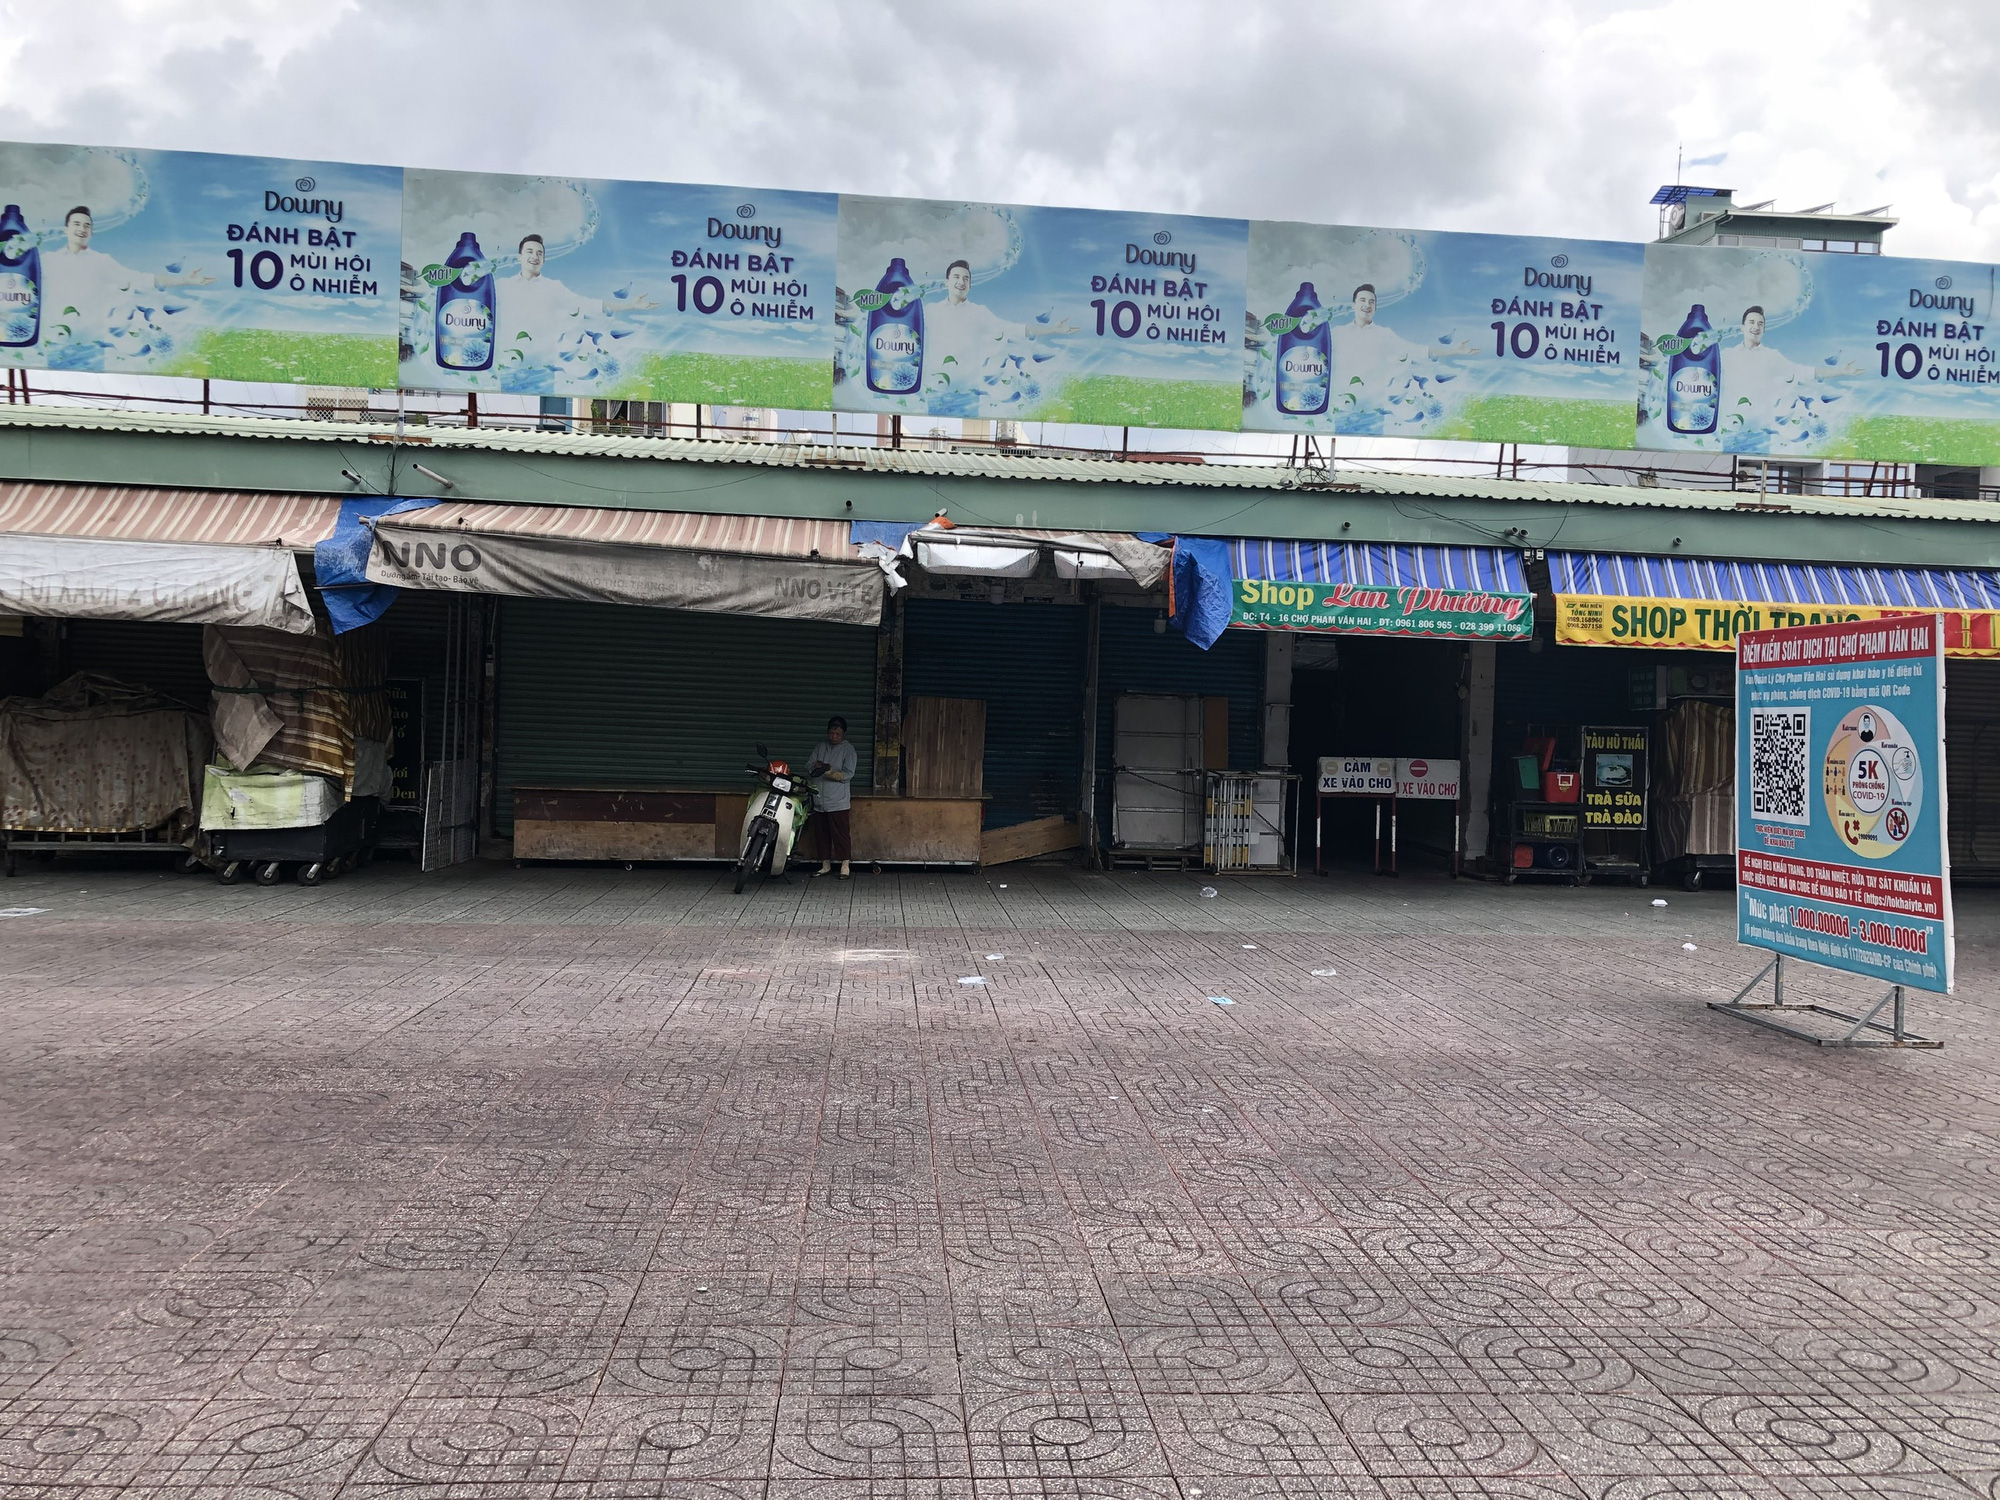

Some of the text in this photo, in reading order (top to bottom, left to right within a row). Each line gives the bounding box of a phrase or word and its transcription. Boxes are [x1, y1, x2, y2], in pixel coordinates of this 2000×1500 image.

[264, 191, 343, 223] Downy
[227, 222, 356, 250] ĐÁNH BẬT
[707, 217, 782, 248] Downy
[291, 253, 371, 272] MÙI HÔI
[671, 248, 794, 276] ĐÁNH BẬT
[1126, 243, 1195, 274] Downy
[227, 249, 283, 290] 10
[427, 267, 452, 281] MỚI!
[290, 274, 377, 295] Ô NHIỄM
[731, 278, 807, 297] MÙI HÔI
[1091, 273, 1207, 302] ĐÁNH BẬT
[1524, 266, 1592, 296] Downy
[671, 275, 725, 314] 10
[859, 292, 882, 307] MỚI!
[1909, 288, 1974, 318] Downy
[730, 300, 814, 320] Ô NHIỄM
[1090, 299, 1141, 338] 10
[1147, 303, 1220, 322] MÙI HÔI
[1491, 297, 1603, 323] ĐÁNH BẬT
[445, 313, 486, 331] Downy
[1270, 316, 1293, 330] MỚI!
[1877, 318, 1984, 343] ĐÁNH BẬT
[1146, 324, 1225, 344] Ô NHIỄM
[1491, 321, 1540, 359] 10
[1545, 324, 1615, 343] MÙI HÔI
[876, 337, 914, 355] Downy
[1661, 337, 1684, 352] MỚI!
[1929, 345, 1995, 363] MÙI HÔI
[1544, 344, 1620, 365] Ô NHIỄM
[1876, 342, 1923, 380] 10
[1285, 360, 1323, 377] Downy
[1928, 365, 1940, 380] Ô
[1676, 380, 1712, 396] Downy
[382, 541, 481, 572] NNO
[1241, 579, 1525, 620] Shop Lan Phương
[1243, 612, 1257, 620] ĐC:
[1260, 613, 1270, 621] T4
[1279, 614, 1289, 622] 16
[1291, 614, 1309, 624] CHỢ
[1311, 615, 1335, 625] PHẠM
[1338, 615, 1355, 625] VĂN
[1357, 617, 1371, 625] HAI
[1379, 618, 1393, 627] ĐT:
[1395, 619, 1415, 628] 0961
[1418, 620, 1433, 628] 806
[1437, 621, 1452, 629] 965
[1460, 622, 1476, 630] 028
[1478, 622, 1494, 631] 399
[1611, 605, 1687, 638] SHOP
[1694, 603, 1760, 641] THỜI
[1761, 634, 1780, 662] KIỂM
[1782, 636, 1801, 661] SOÁT
[1803, 637, 1822, 661] DỊCH
[1825, 636, 1838, 661] TẠI
[1840, 632, 1859, 659] CHỢ
[1860, 631, 1886, 660] PHẠM
[1889, 625, 1908, 652] VĂN
[1911, 626, 1929, 651] HAI
[1822, 686, 1850, 699] COVID-19
[1881, 685, 1891, 697] QR
[1893, 684, 1910, 695] Code
[1606, 733, 1620, 749] HŨ
[1622, 733, 1644, 750] THÁI
[1858, 761, 1878, 779] 5K
[1323, 777, 1337, 788] XE
[1341, 775, 1364, 788] VÀO
[1403, 782, 1414, 794] XE
[1417, 779, 1435, 795] VÀO
[1853, 781, 1885, 790] PHÒNG CHỐNG
[1586, 790, 1641, 806] TRÀ SỮA
[1853, 791, 1885, 801] COVID-19
[1585, 809, 1642, 825] TRÀ ĐÀO
[1820, 884, 1834, 897] KHAI
[1835, 886, 1847, 900] BÁO
[1849, 889, 1853, 901] Y
[1854, 888, 1862, 902] TẾ
[1866, 875, 1877, 888] TAY
[1879, 875, 1892, 891] SÁT
[1894, 877, 1919, 894] KHUẨN
[1921, 881, 1932, 896] VÀ
[1769, 903, 1788, 928] phạt
